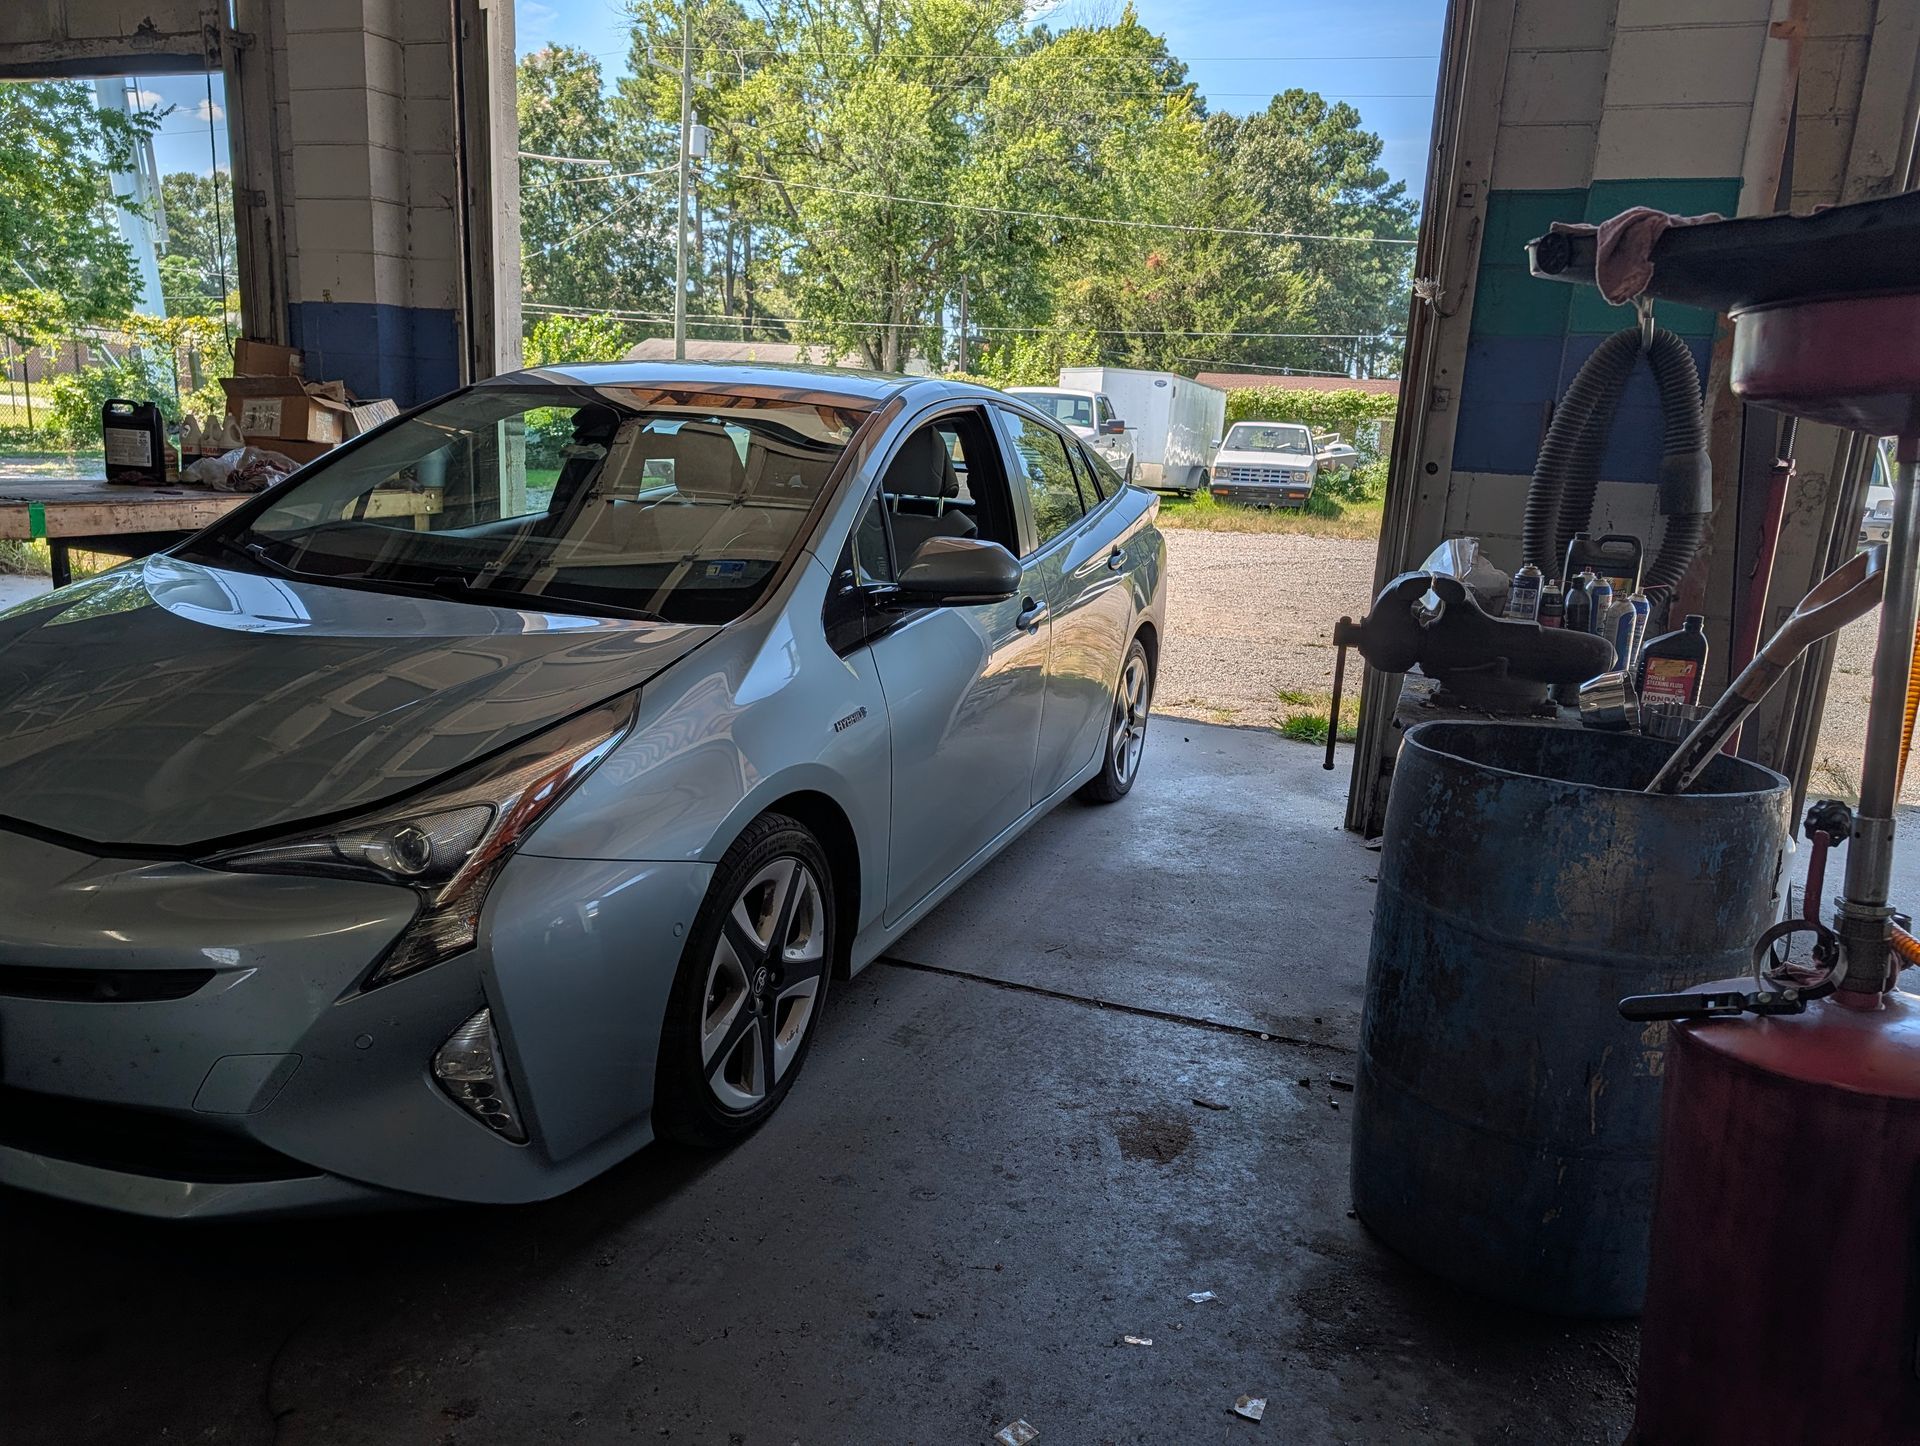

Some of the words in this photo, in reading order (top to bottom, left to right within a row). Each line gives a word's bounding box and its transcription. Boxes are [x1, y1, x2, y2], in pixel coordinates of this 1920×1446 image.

[1646, 680, 1669, 688] STEERING
[1643, 694, 1677, 704] HONDA
[834, 709, 863, 733] HYBRID
